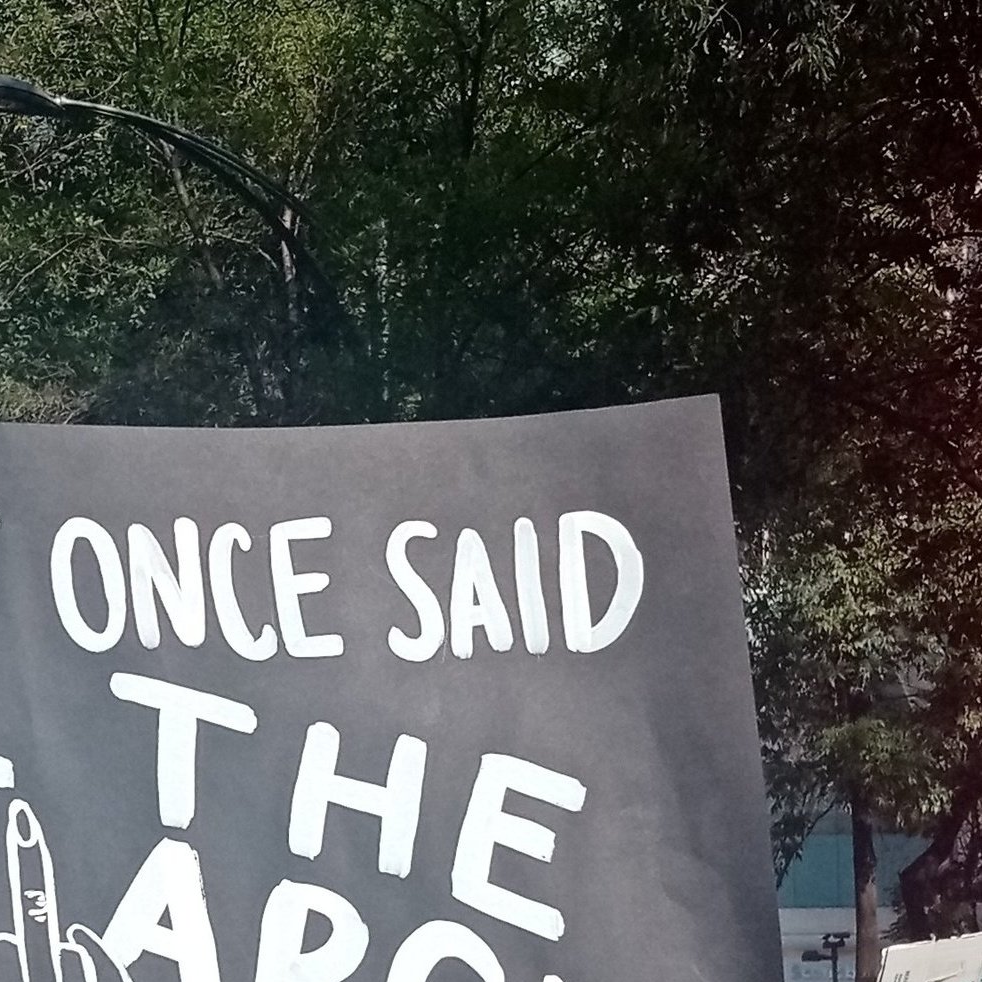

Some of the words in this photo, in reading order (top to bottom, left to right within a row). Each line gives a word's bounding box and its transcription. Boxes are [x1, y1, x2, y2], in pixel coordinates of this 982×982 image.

[50, 515, 344, 662] ONCE
[384, 510, 645, 662] SAID
[109, 671, 588, 942] THE
